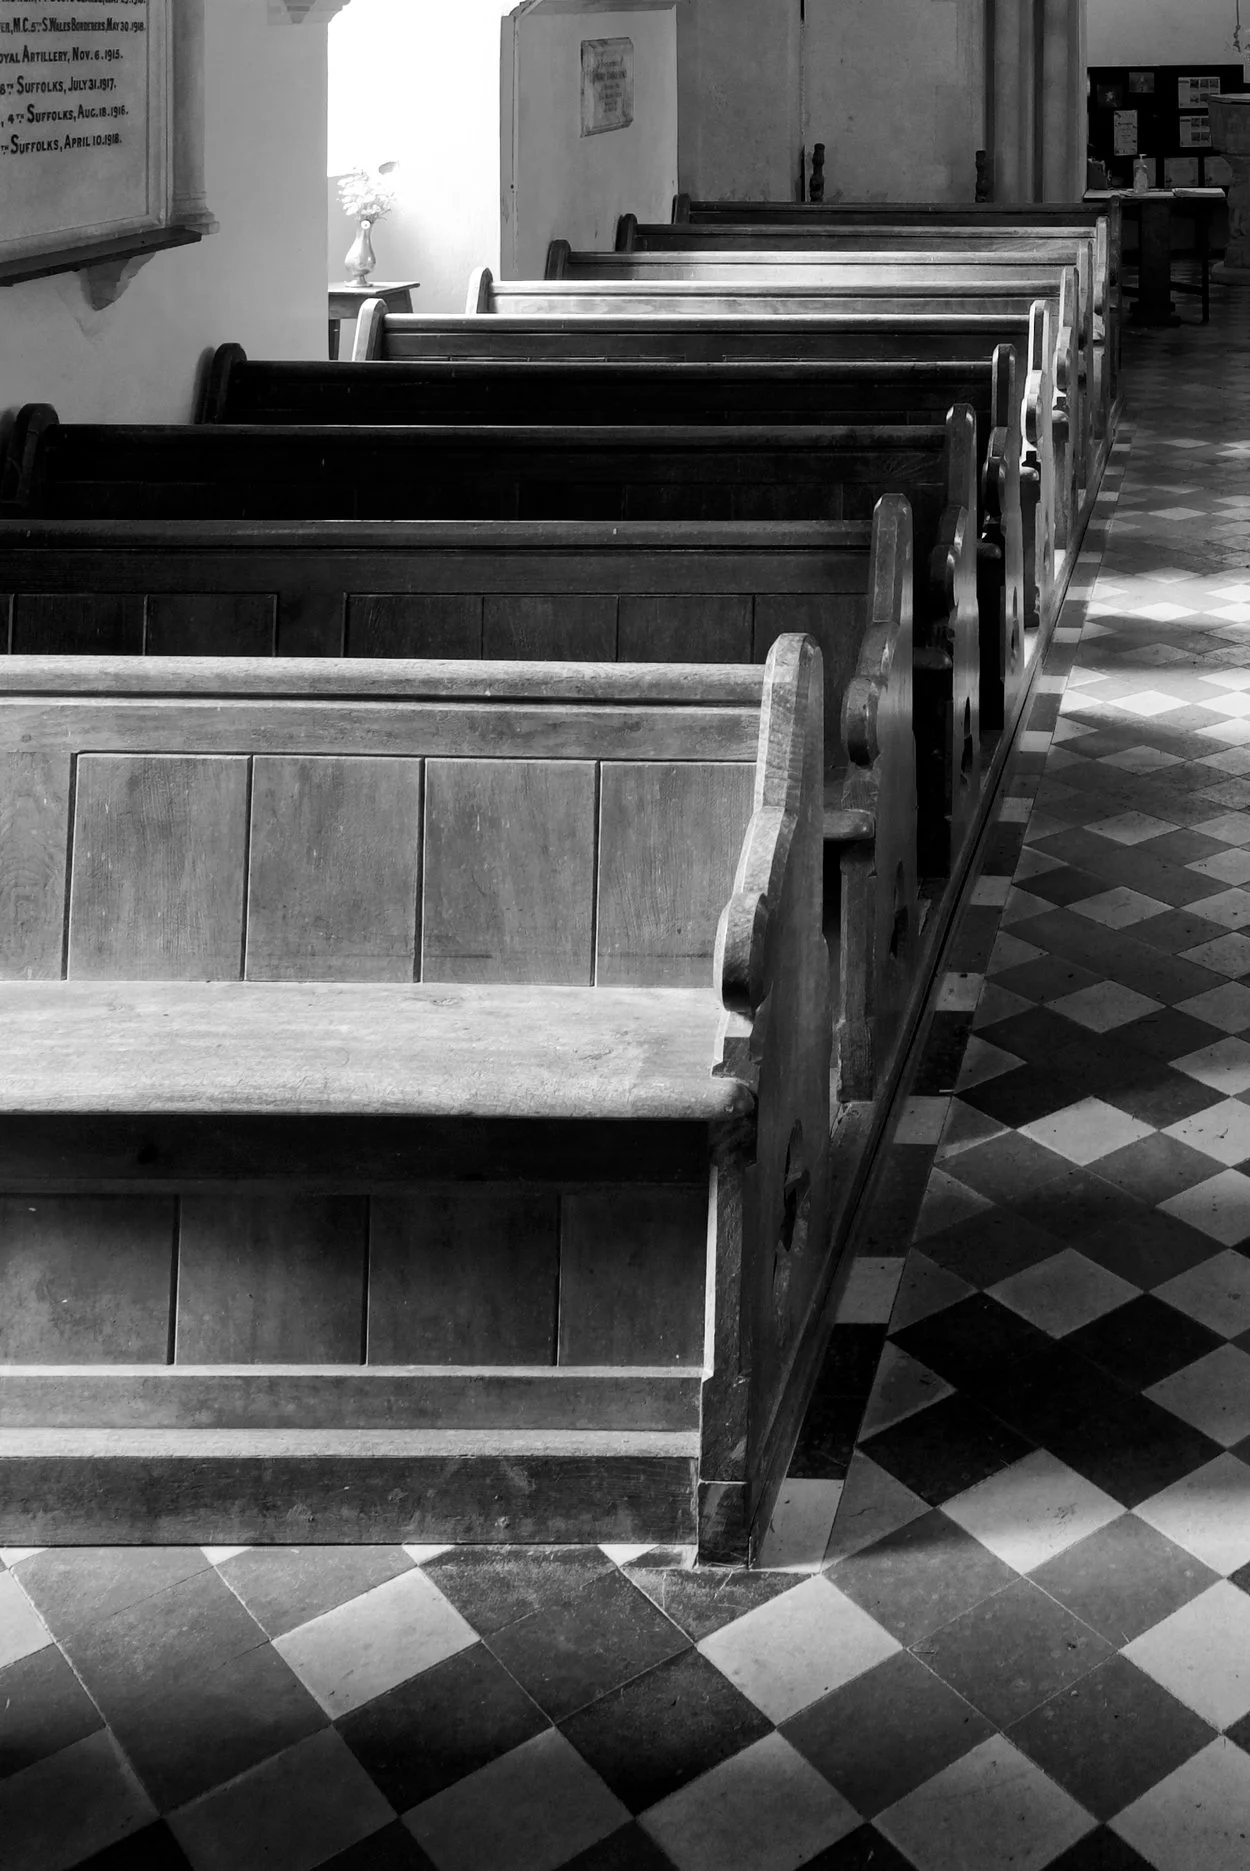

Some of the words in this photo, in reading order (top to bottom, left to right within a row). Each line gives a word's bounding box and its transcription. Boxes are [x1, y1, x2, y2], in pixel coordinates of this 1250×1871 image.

[22, 45, 70, 64] ARTILLERY,
[72, 47, 93, 61] NOV.
[16, 75, 67, 96] SUFFOLKS,
[68, 76, 89, 92] JULY
[27, 103, 77, 124] SUFFOLKS,
[77, 104, 98, 119] AUG.
[10, 134, 63, 155] SUFFOLKS,
[64, 134, 91, 149] APRIL
